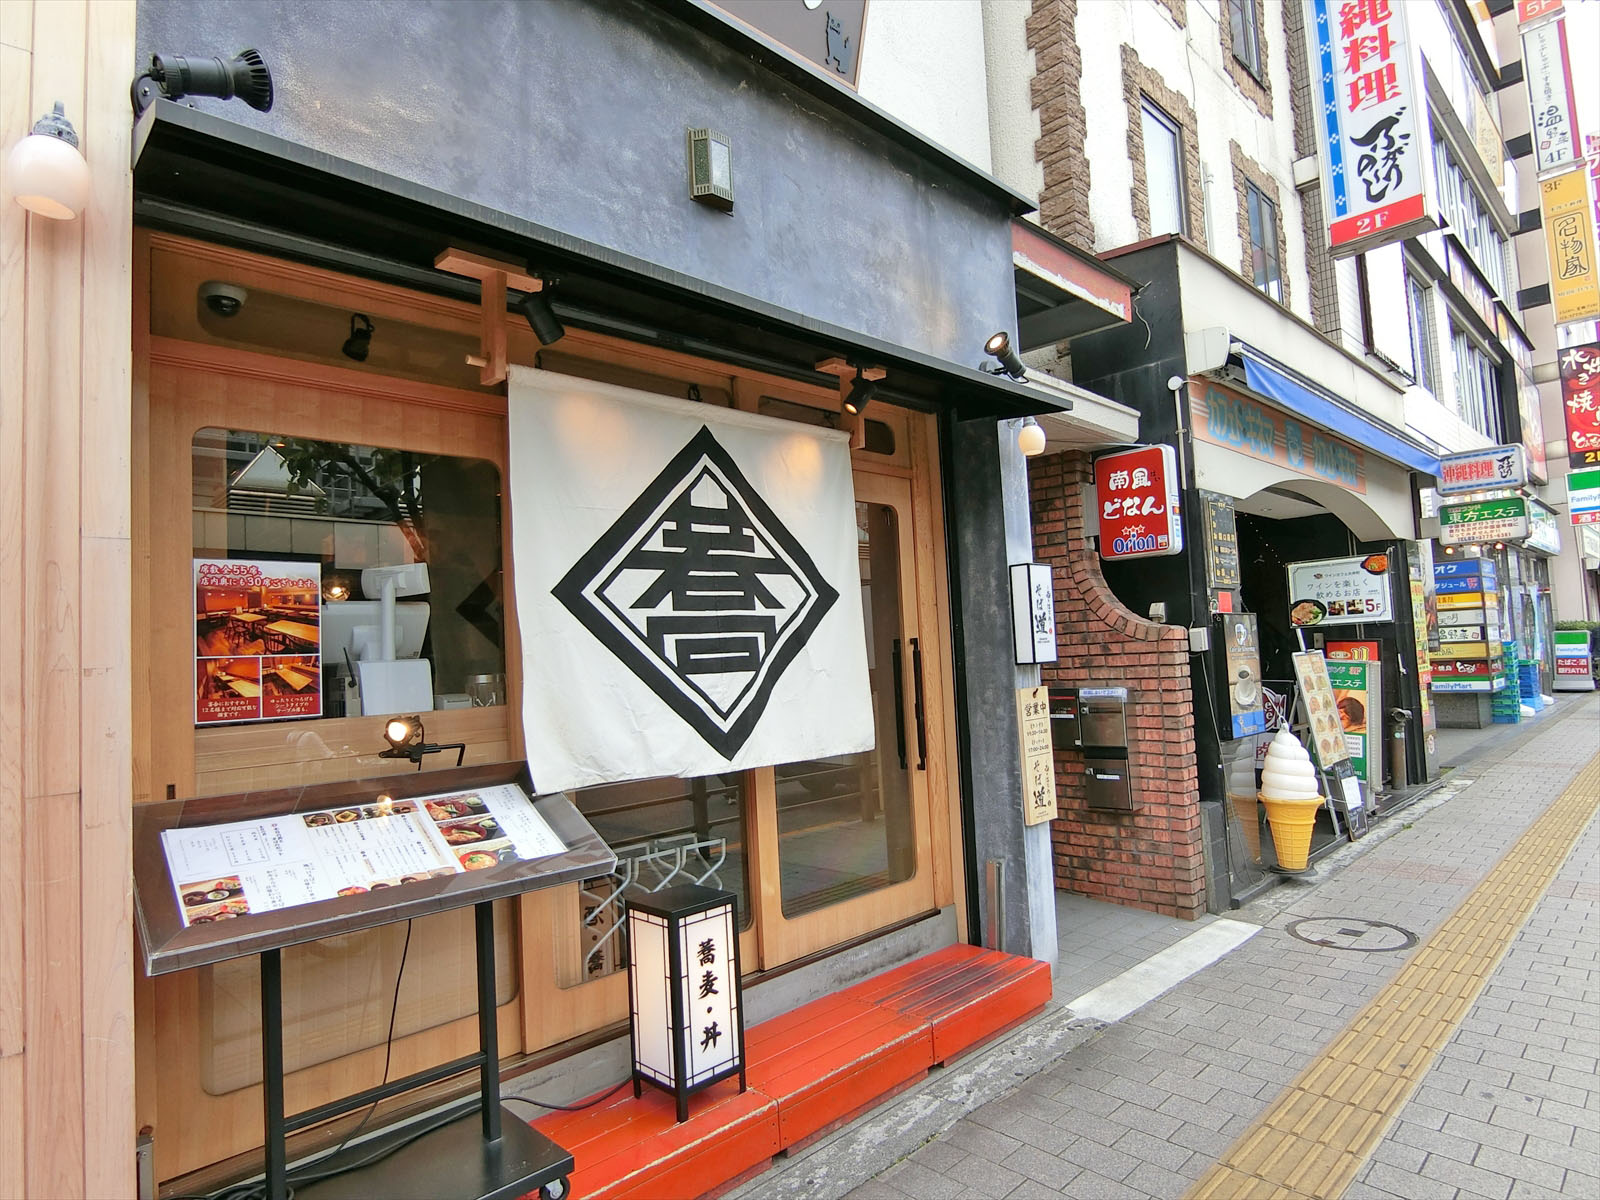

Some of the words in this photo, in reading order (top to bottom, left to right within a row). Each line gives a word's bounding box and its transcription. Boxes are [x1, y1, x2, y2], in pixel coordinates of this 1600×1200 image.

[1544, 147, 1568, 163] 4F
[1544, 179, 1562, 193] 3F
[1356, 211, 1389, 234] 2F
[1109, 467, 1151, 491] 南風
[1442, 459, 1494, 483] 沖縄料理
[1103, 496, 1164, 519] どなん
[1448, 506, 1519, 524] 東方エステ
[1113, 533, 1155, 554] Orion
[1307, 578, 1368, 591] ワインを楽しく
[1316, 588, 1361, 599] 飲めるお店
[1365, 599, 1381, 613] 5F
[1025, 702, 1047, 717] 営業中
[697, 938, 722, 1053] 蕎麦・丼
